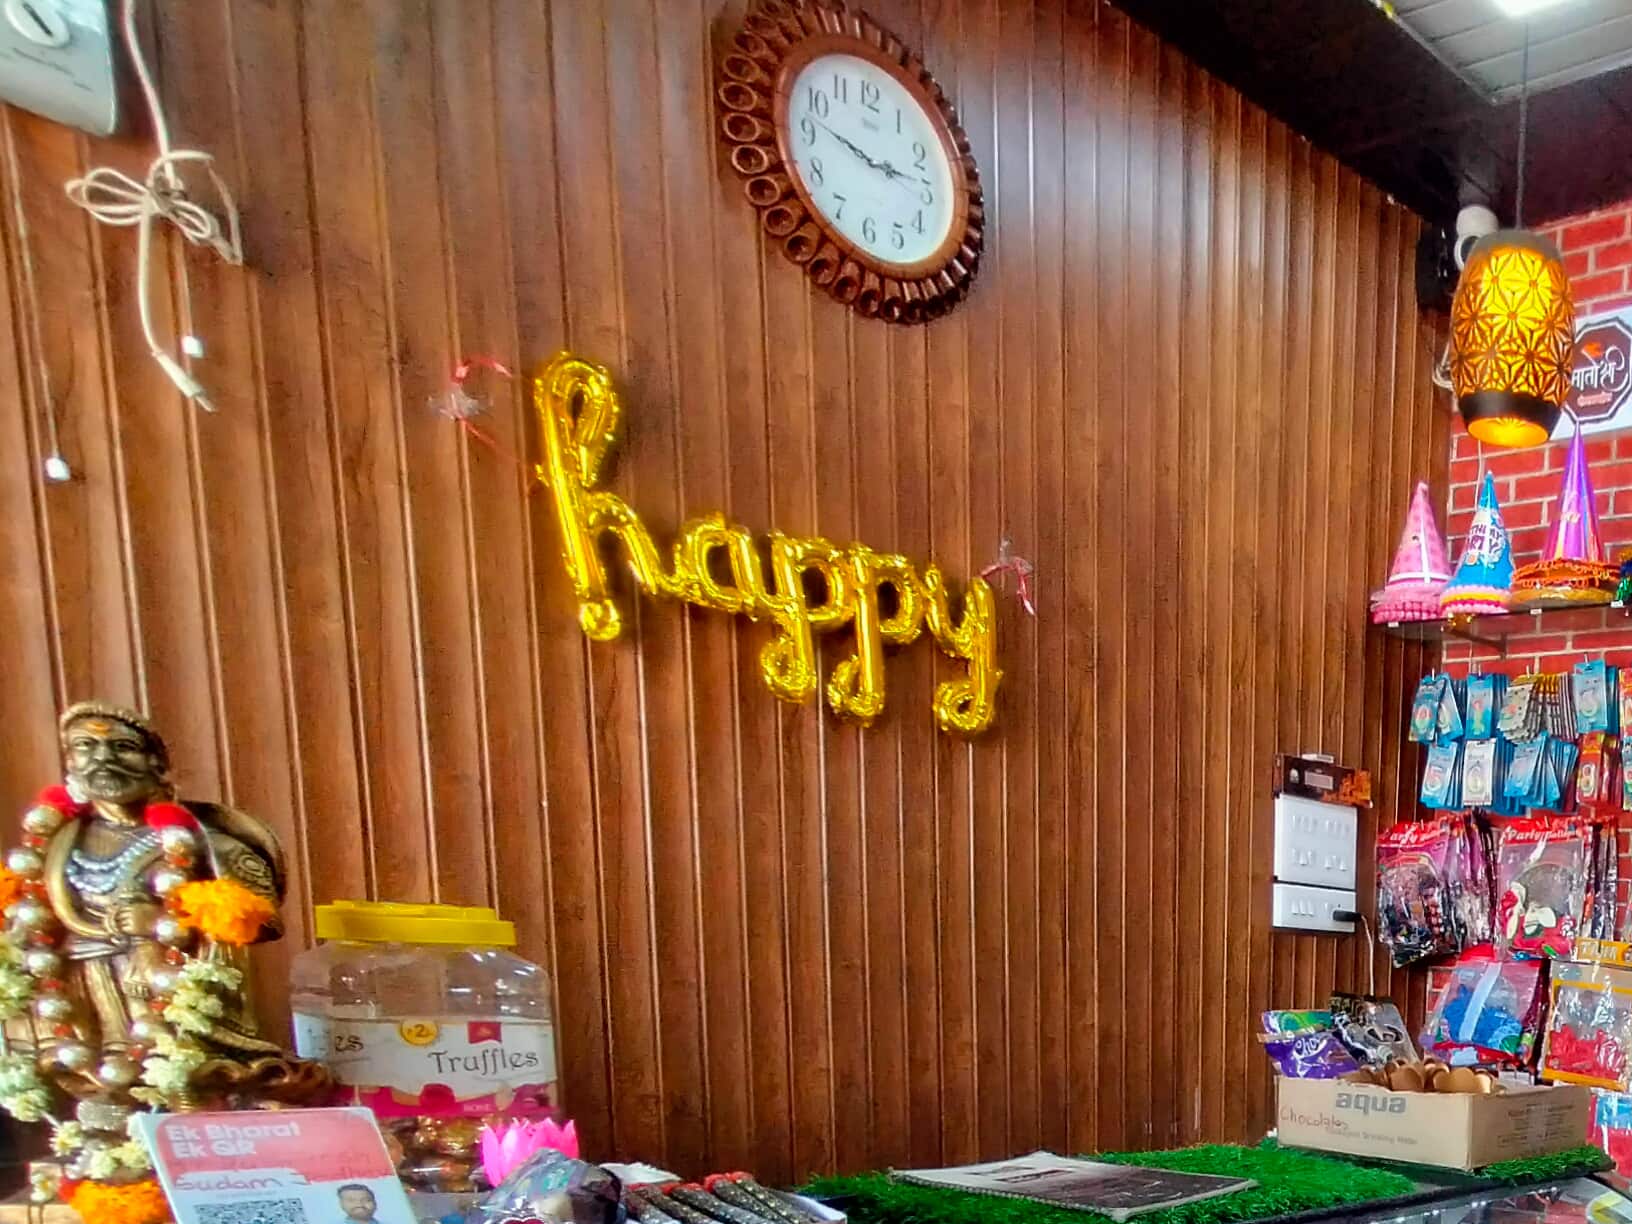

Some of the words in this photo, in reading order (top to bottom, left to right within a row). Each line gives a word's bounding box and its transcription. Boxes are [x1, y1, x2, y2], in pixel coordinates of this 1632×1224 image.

[808, 85, 829, 118] 10
[834, 74, 847, 103] 11
[860, 80, 880, 113] 12
[801, 117, 816, 146] 9
[912, 142, 926, 171] 2
[810, 158, 824, 186] 8
[832, 192, 847, 219] 7
[920, 178, 934, 206] 3
[862, 217, 876, 244] 6
[892, 222, 905, 250] 5
[911, 210, 925, 234] 4
[535, 352, 998, 731] happy
[428, 1049, 539, 1076] Truffles
[1335, 1090, 1406, 1116] aqua
[165, 1125, 201, 1140] Ek
[205, 1121, 300, 1140] Bharat
[172, 1141, 209, 1159] Ek
